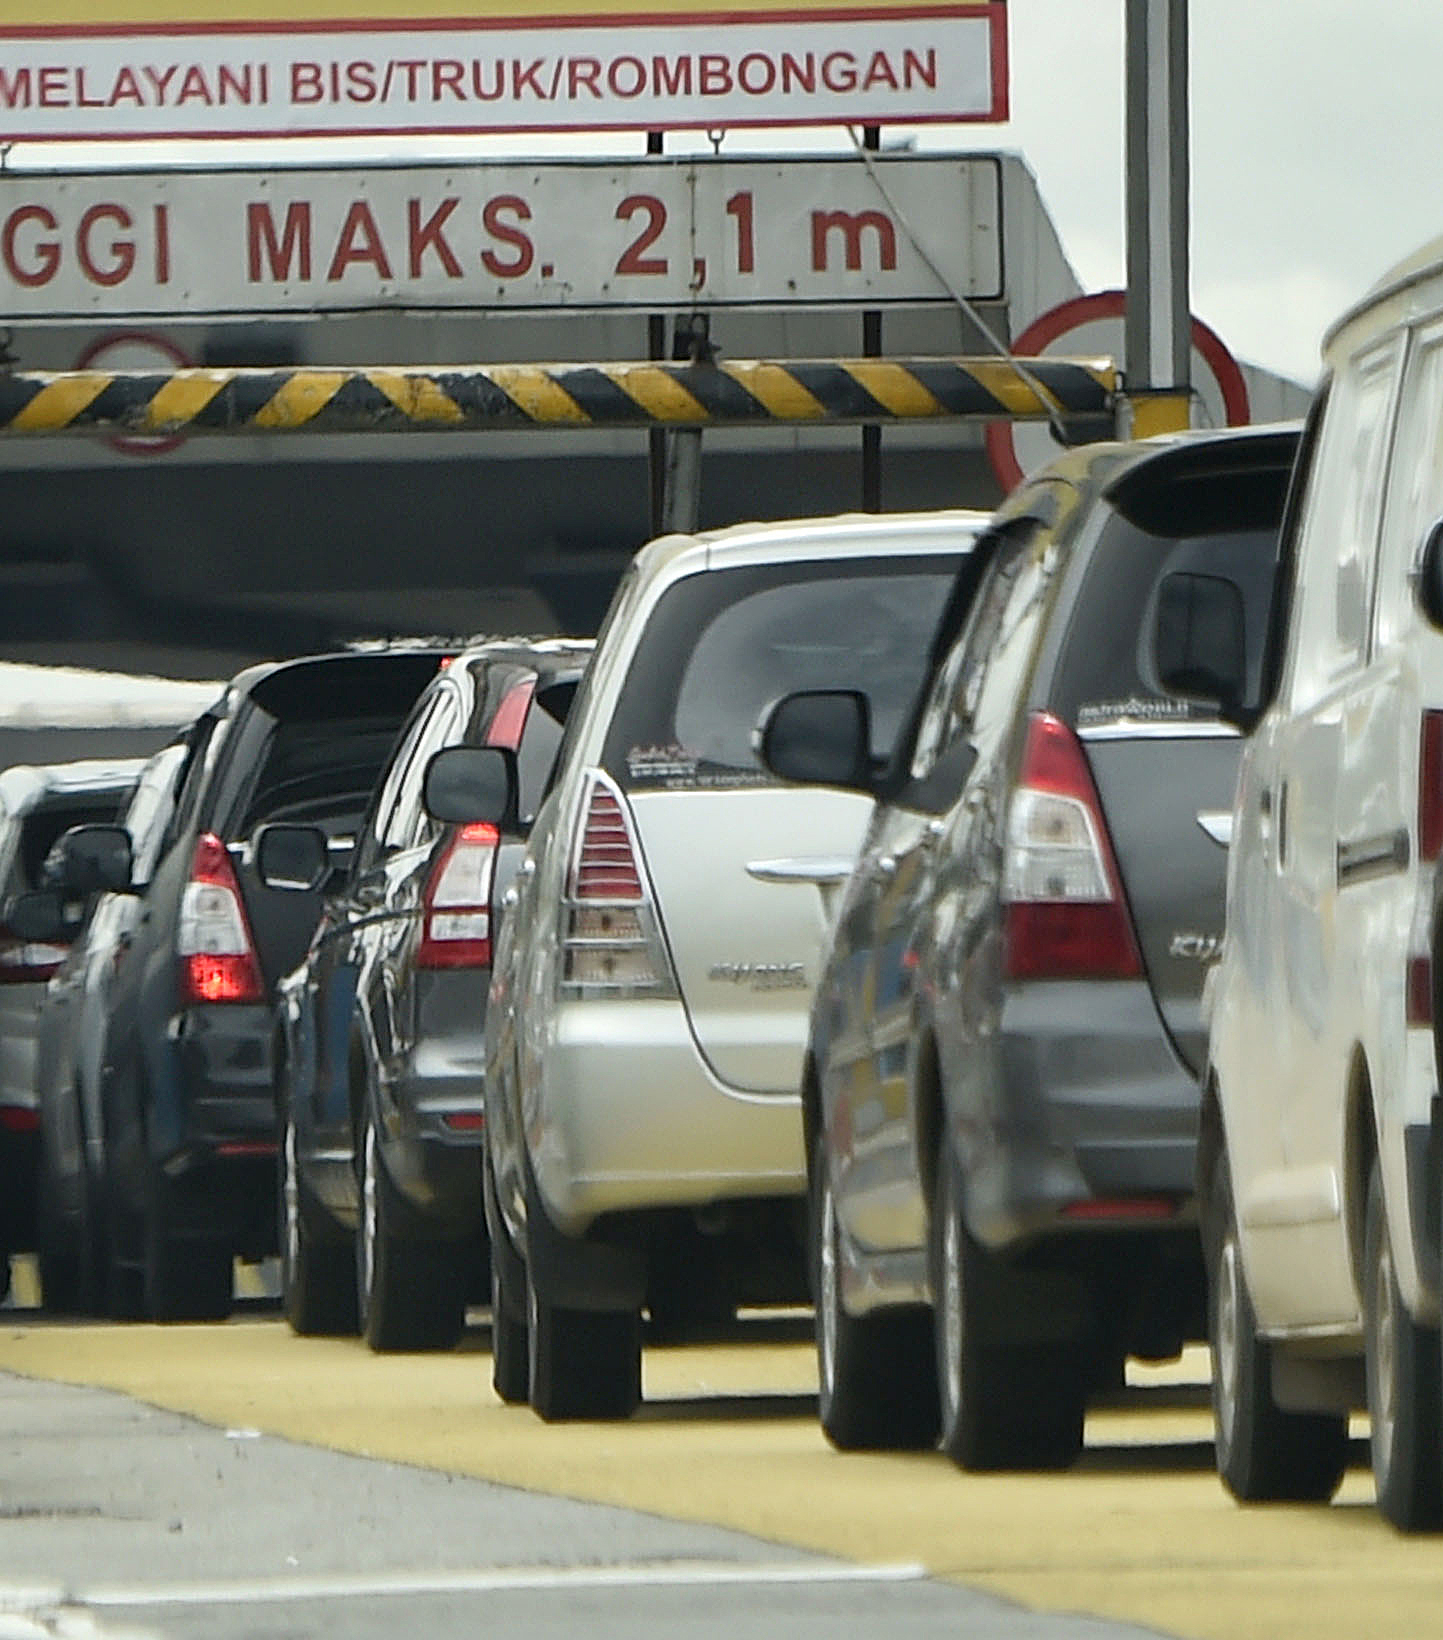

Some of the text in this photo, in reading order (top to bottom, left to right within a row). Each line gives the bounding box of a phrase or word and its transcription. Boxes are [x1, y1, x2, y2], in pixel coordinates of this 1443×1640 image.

[291, 50, 939, 105] BIS/TRUK/ROMBONGAN
[248, 196, 553, 283] MAKS.
[615, 192, 754, 281] 2,1
[812, 211, 897, 273] m
